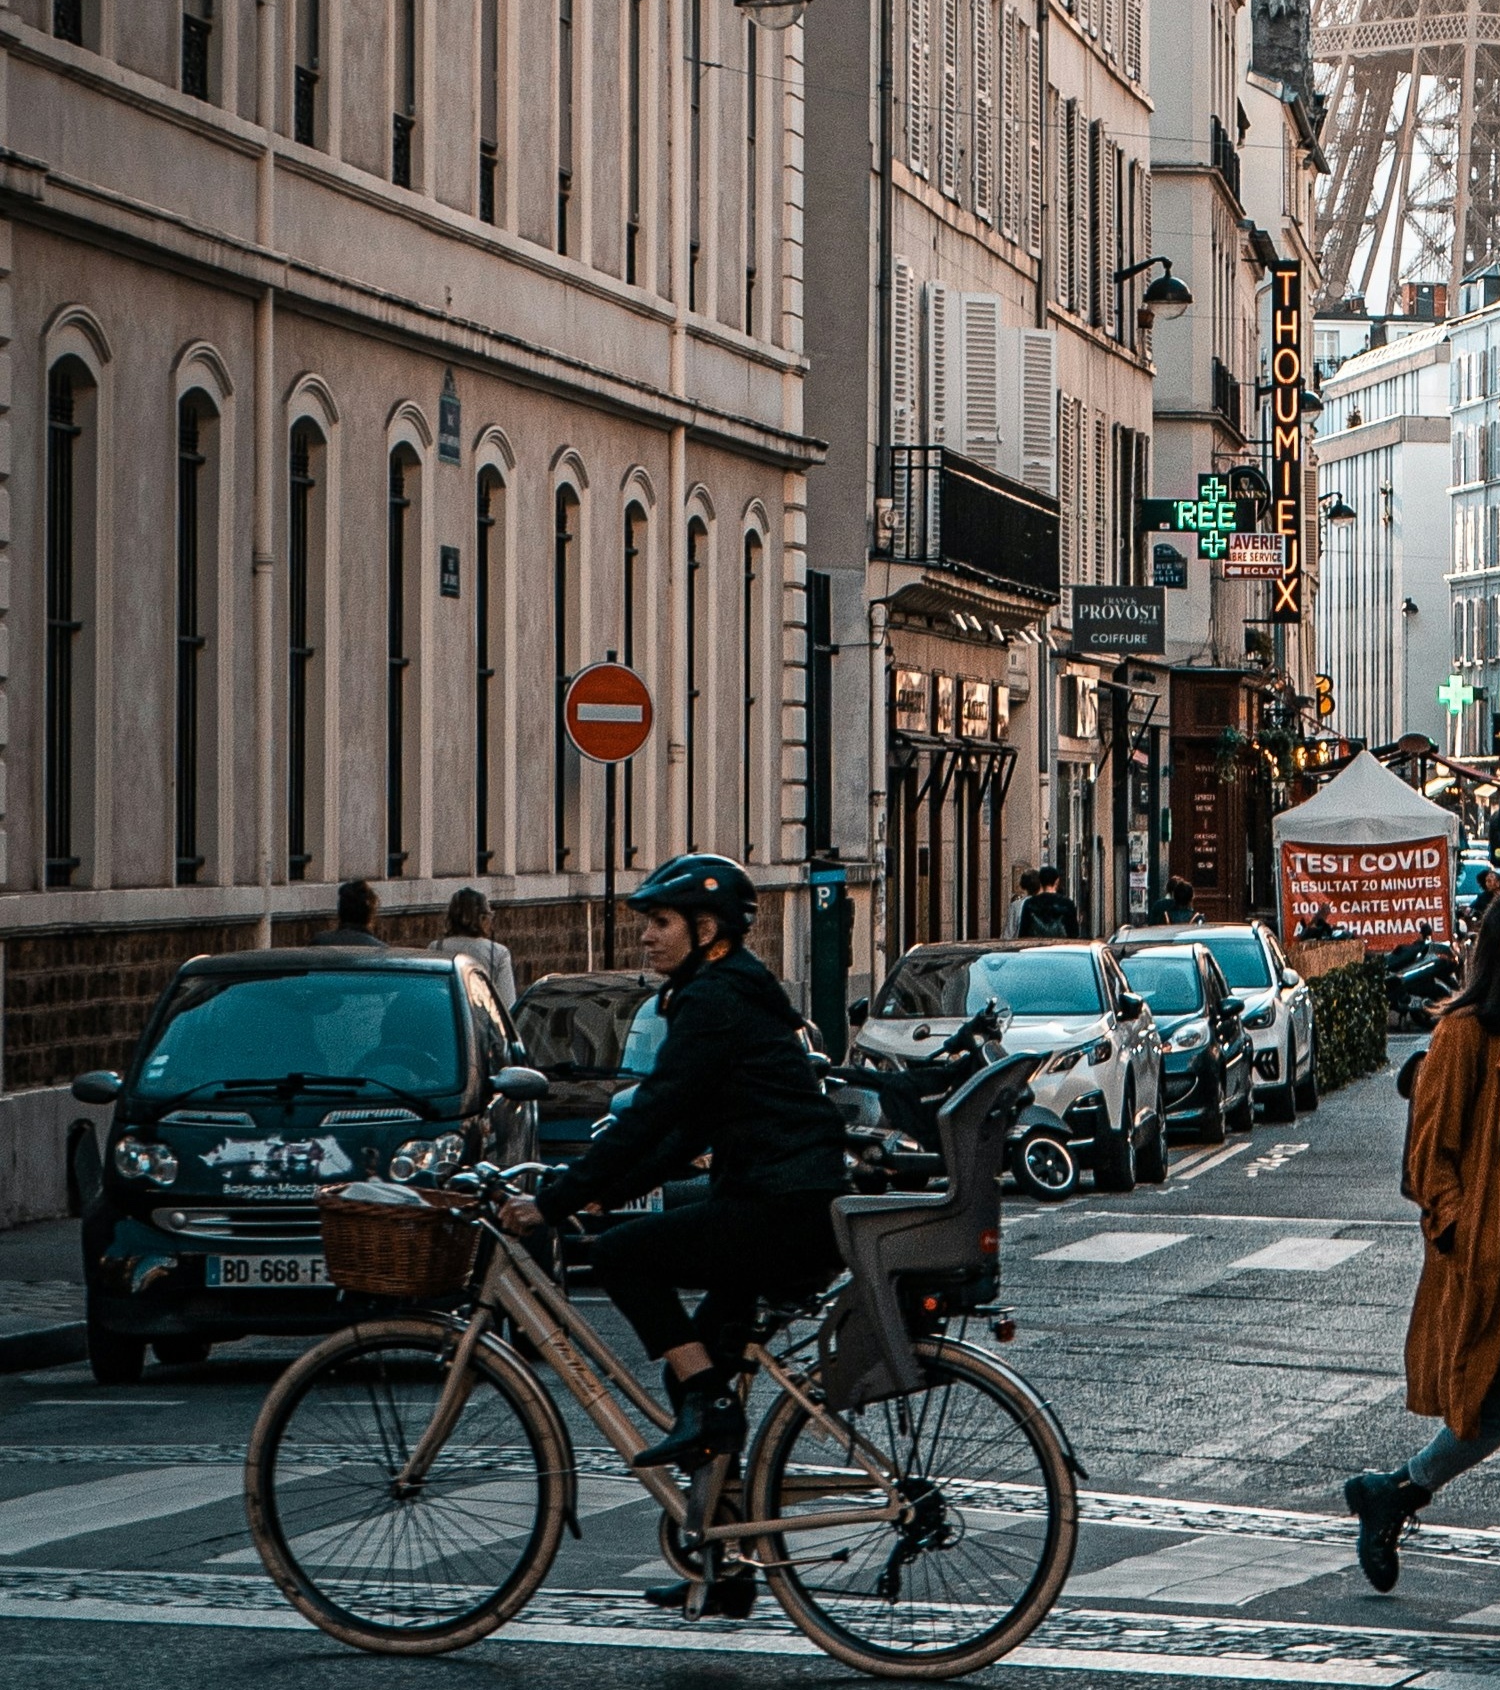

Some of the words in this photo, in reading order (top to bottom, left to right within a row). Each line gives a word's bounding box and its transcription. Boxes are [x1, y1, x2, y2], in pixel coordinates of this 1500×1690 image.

[1274, 270, 1300, 613] THOUMIEUX
[1231, 534, 1283, 551] AVERIE
[1231, 551, 1248, 562] BRE
[1250, 551, 1283, 563] SERVICE
[1244, 567, 1281, 576] ECLAT
[1103, 597, 1137, 605] FRANCK
[1079, 604, 1160, 620] PROVOST
[1090, 633, 1148, 644] COIFFURE
[1290, 853, 1354, 874] TEST
[1359, 848, 1440, 872] COVID
[1291, 880, 1358, 893] RESULTAT
[1361, 879, 1378, 891] 20
[1381, 876, 1441, 891] MINUTES
[1292, 902, 1318, 915] 100
[1340, 899, 1389, 914] CARTE
[1392, 896, 1443, 911] VITALE
[1336, 916, 1444, 936] PHARMACIE
[223, 1258, 331, 1283] BD-668-F
